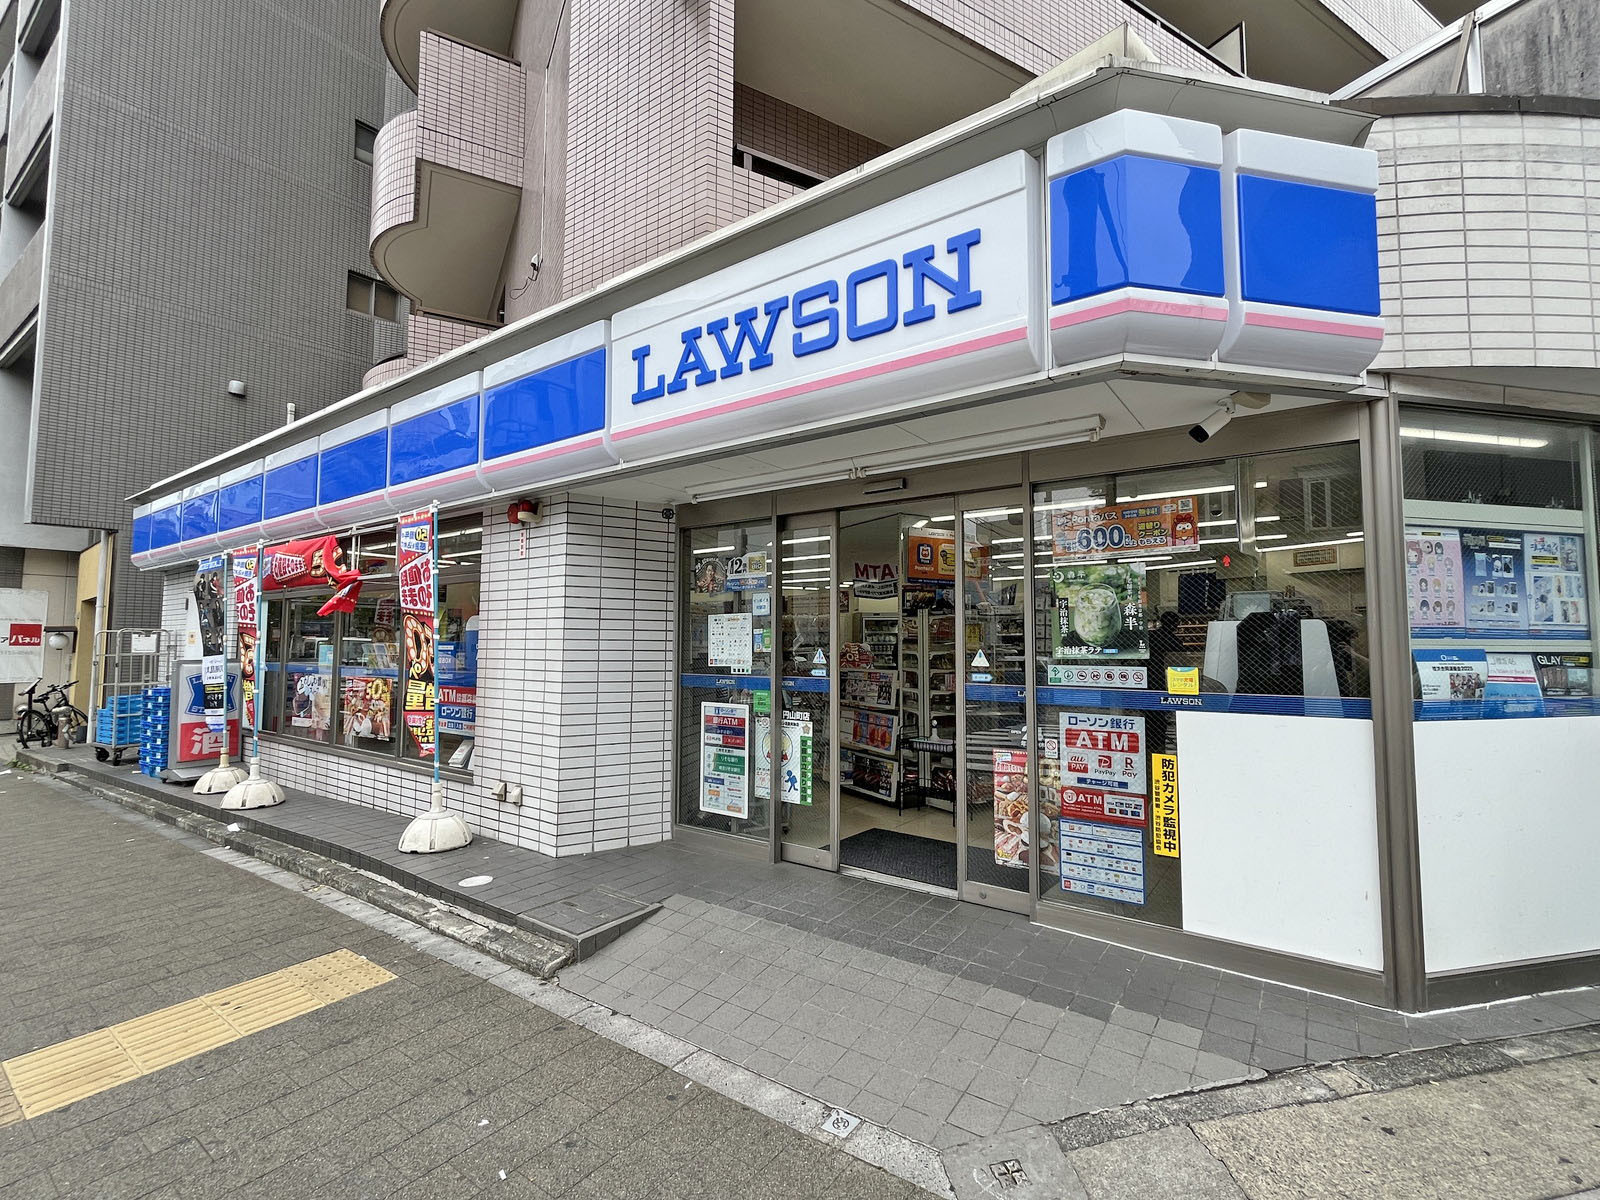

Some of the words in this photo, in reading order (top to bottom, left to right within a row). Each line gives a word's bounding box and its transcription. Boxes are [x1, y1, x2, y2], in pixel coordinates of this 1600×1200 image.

[632, 228, 982, 405] LAWSON
[1077, 525, 1125, 550] 600
[1059, 600, 1069, 633] 宇治抹茶
[1123, 602, 1138, 631] 森半
[1056, 647, 1102, 655] 宇治抹茶ラテ
[1537, 655, 1562, 666] GLAY
[439, 687, 456, 703] ATM
[1160, 697, 1203, 706] LAWSON
[441, 706, 473, 719] ローソン銀行
[783, 711, 811, 720] 円山町店
[1068, 716, 1135, 730] ローソン銀行
[191, 726, 231, 755] 酒
[1075, 731, 1129, 751] ATM
[1125, 757, 1134, 769] R
[1095, 769, 1117, 777] PayPay
[1122, 771, 1138, 779] Pay
[1086, 779, 1119, 788] チャージ可能
[1078, 794, 1103, 805] ATM
[1161, 758, 1176, 852] 防犯カメラ監視中
